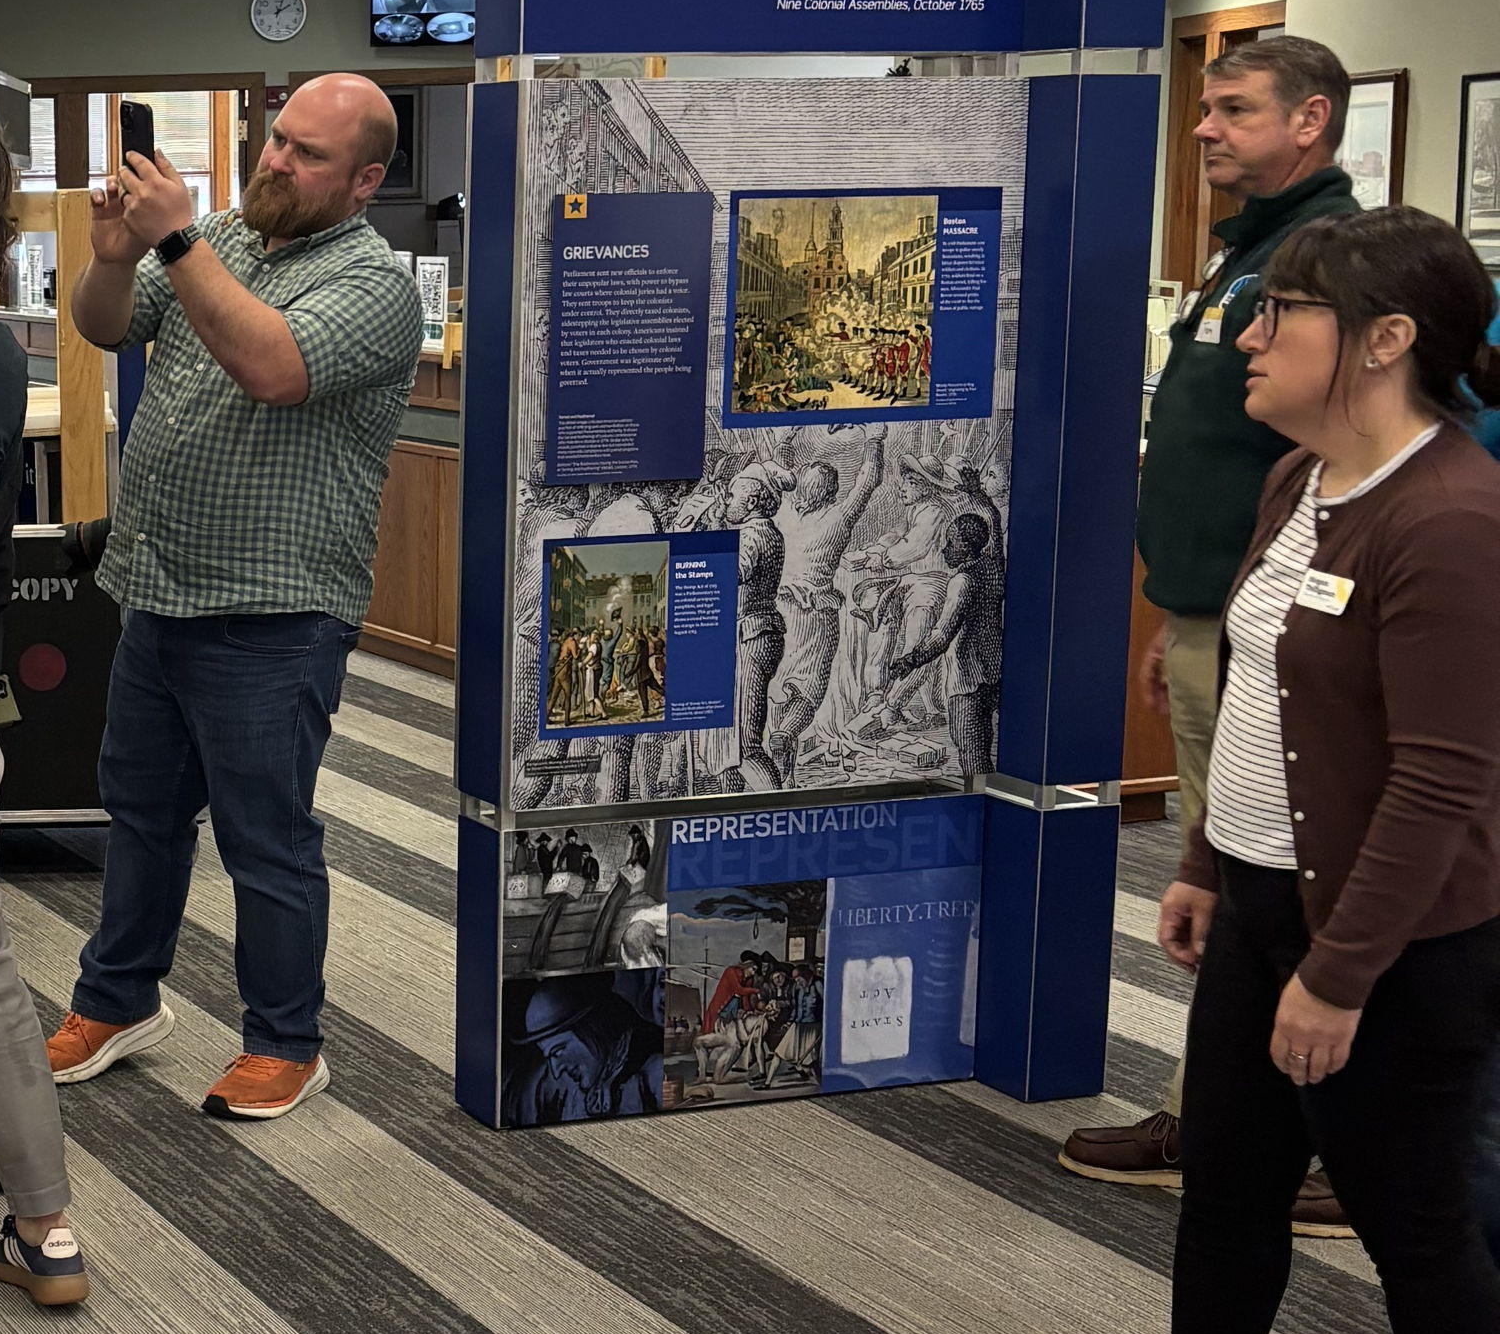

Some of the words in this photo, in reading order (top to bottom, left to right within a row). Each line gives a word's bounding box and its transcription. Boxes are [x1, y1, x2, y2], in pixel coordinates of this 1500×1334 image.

[914, 0, 956, 10] October
[960, 0, 984, 10] 1765
[563, 245, 649, 260] GRIEVANCES
[675, 561, 706, 569] BURNING
[688, 571, 713, 579] Stamps
[672, 803, 897, 845] REPRESENTATION
[859, 986, 895, 1000] ACT
[851, 1016, 904, 1029] STAMP
